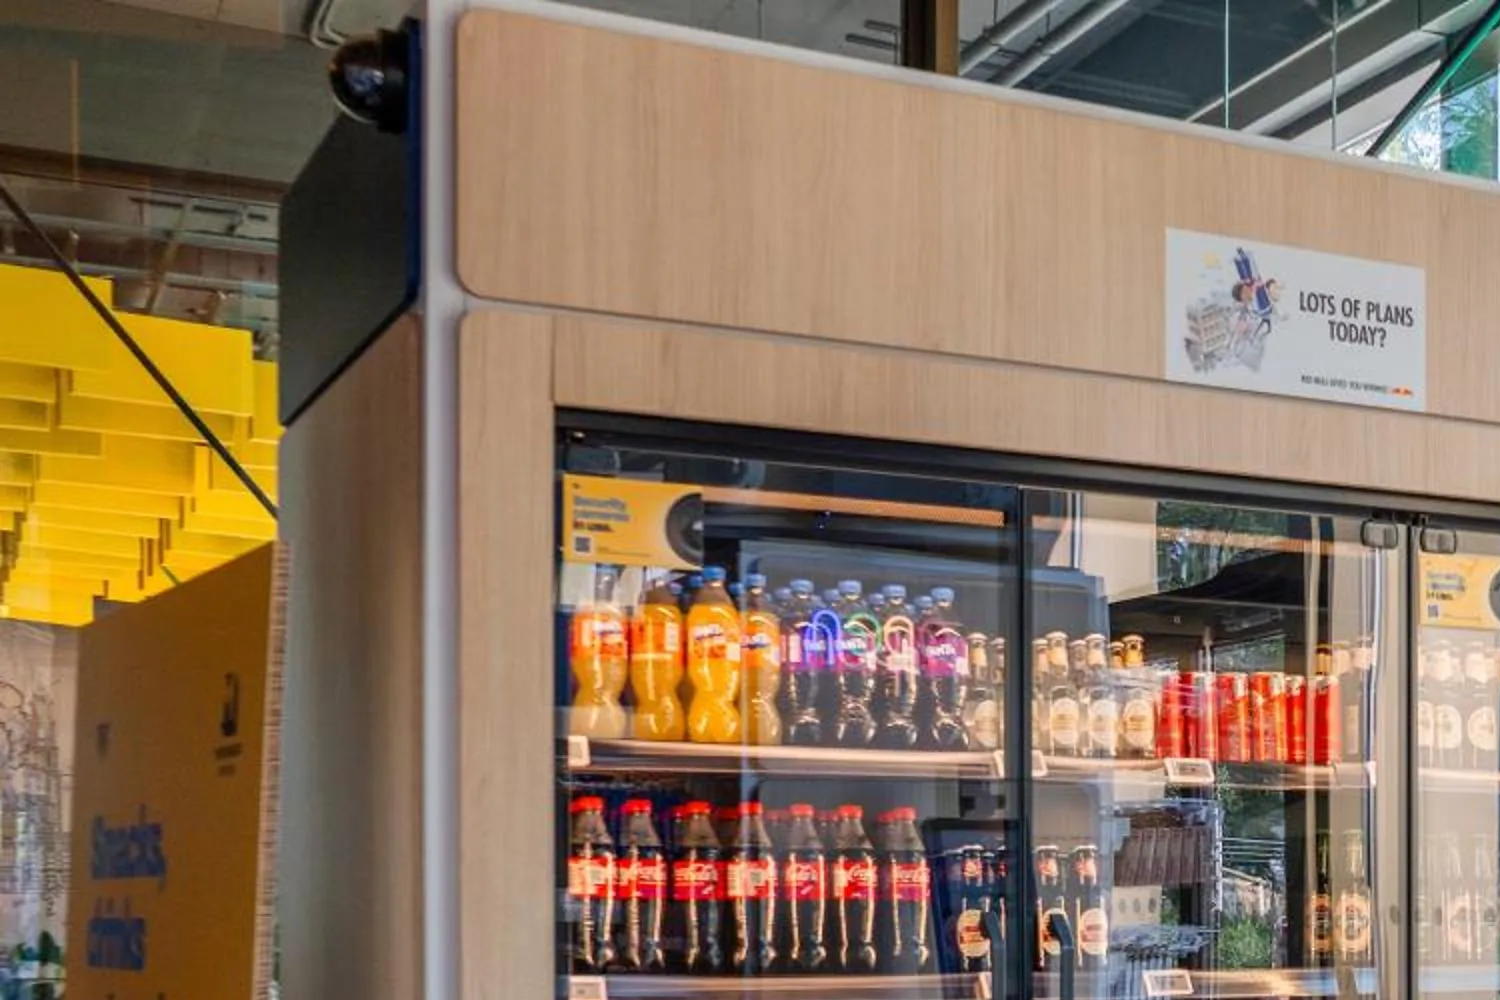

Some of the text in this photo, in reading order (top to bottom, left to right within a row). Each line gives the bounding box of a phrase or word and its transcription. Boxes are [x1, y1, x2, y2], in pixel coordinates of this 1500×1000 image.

[1300, 291, 1414, 326] LOTS OF PLANS
[1328, 320, 1387, 347] TODAY?
